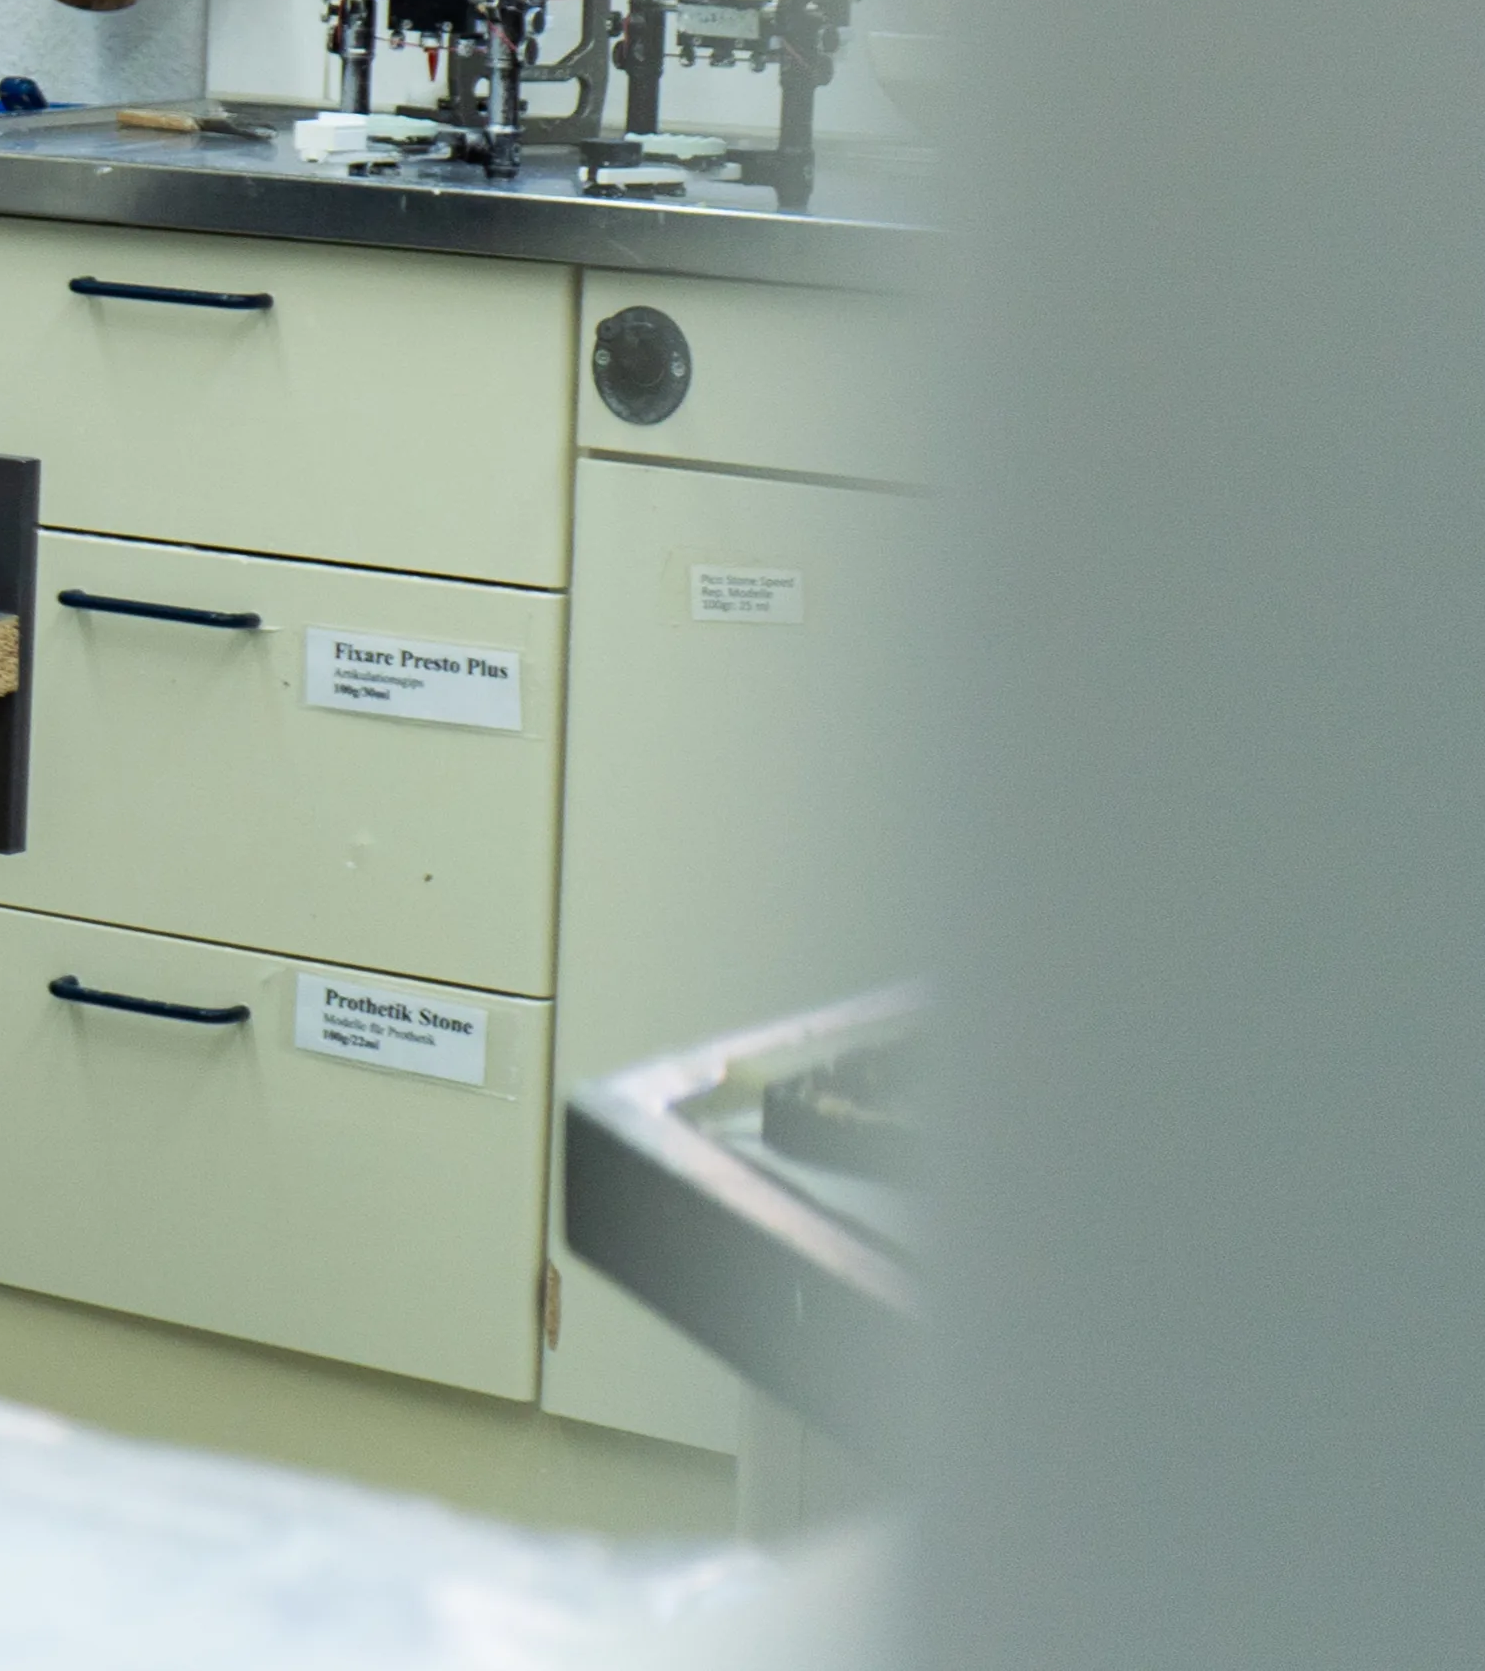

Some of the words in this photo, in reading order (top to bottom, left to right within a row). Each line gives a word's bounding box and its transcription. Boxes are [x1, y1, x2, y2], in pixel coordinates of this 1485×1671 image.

[334, 642, 395, 666] Fixare
[401, 649, 461, 674] Presto
[467, 657, 509, 679] Plus
[325, 988, 413, 1023] Prothetik
[418, 1008, 474, 1035] Stone
